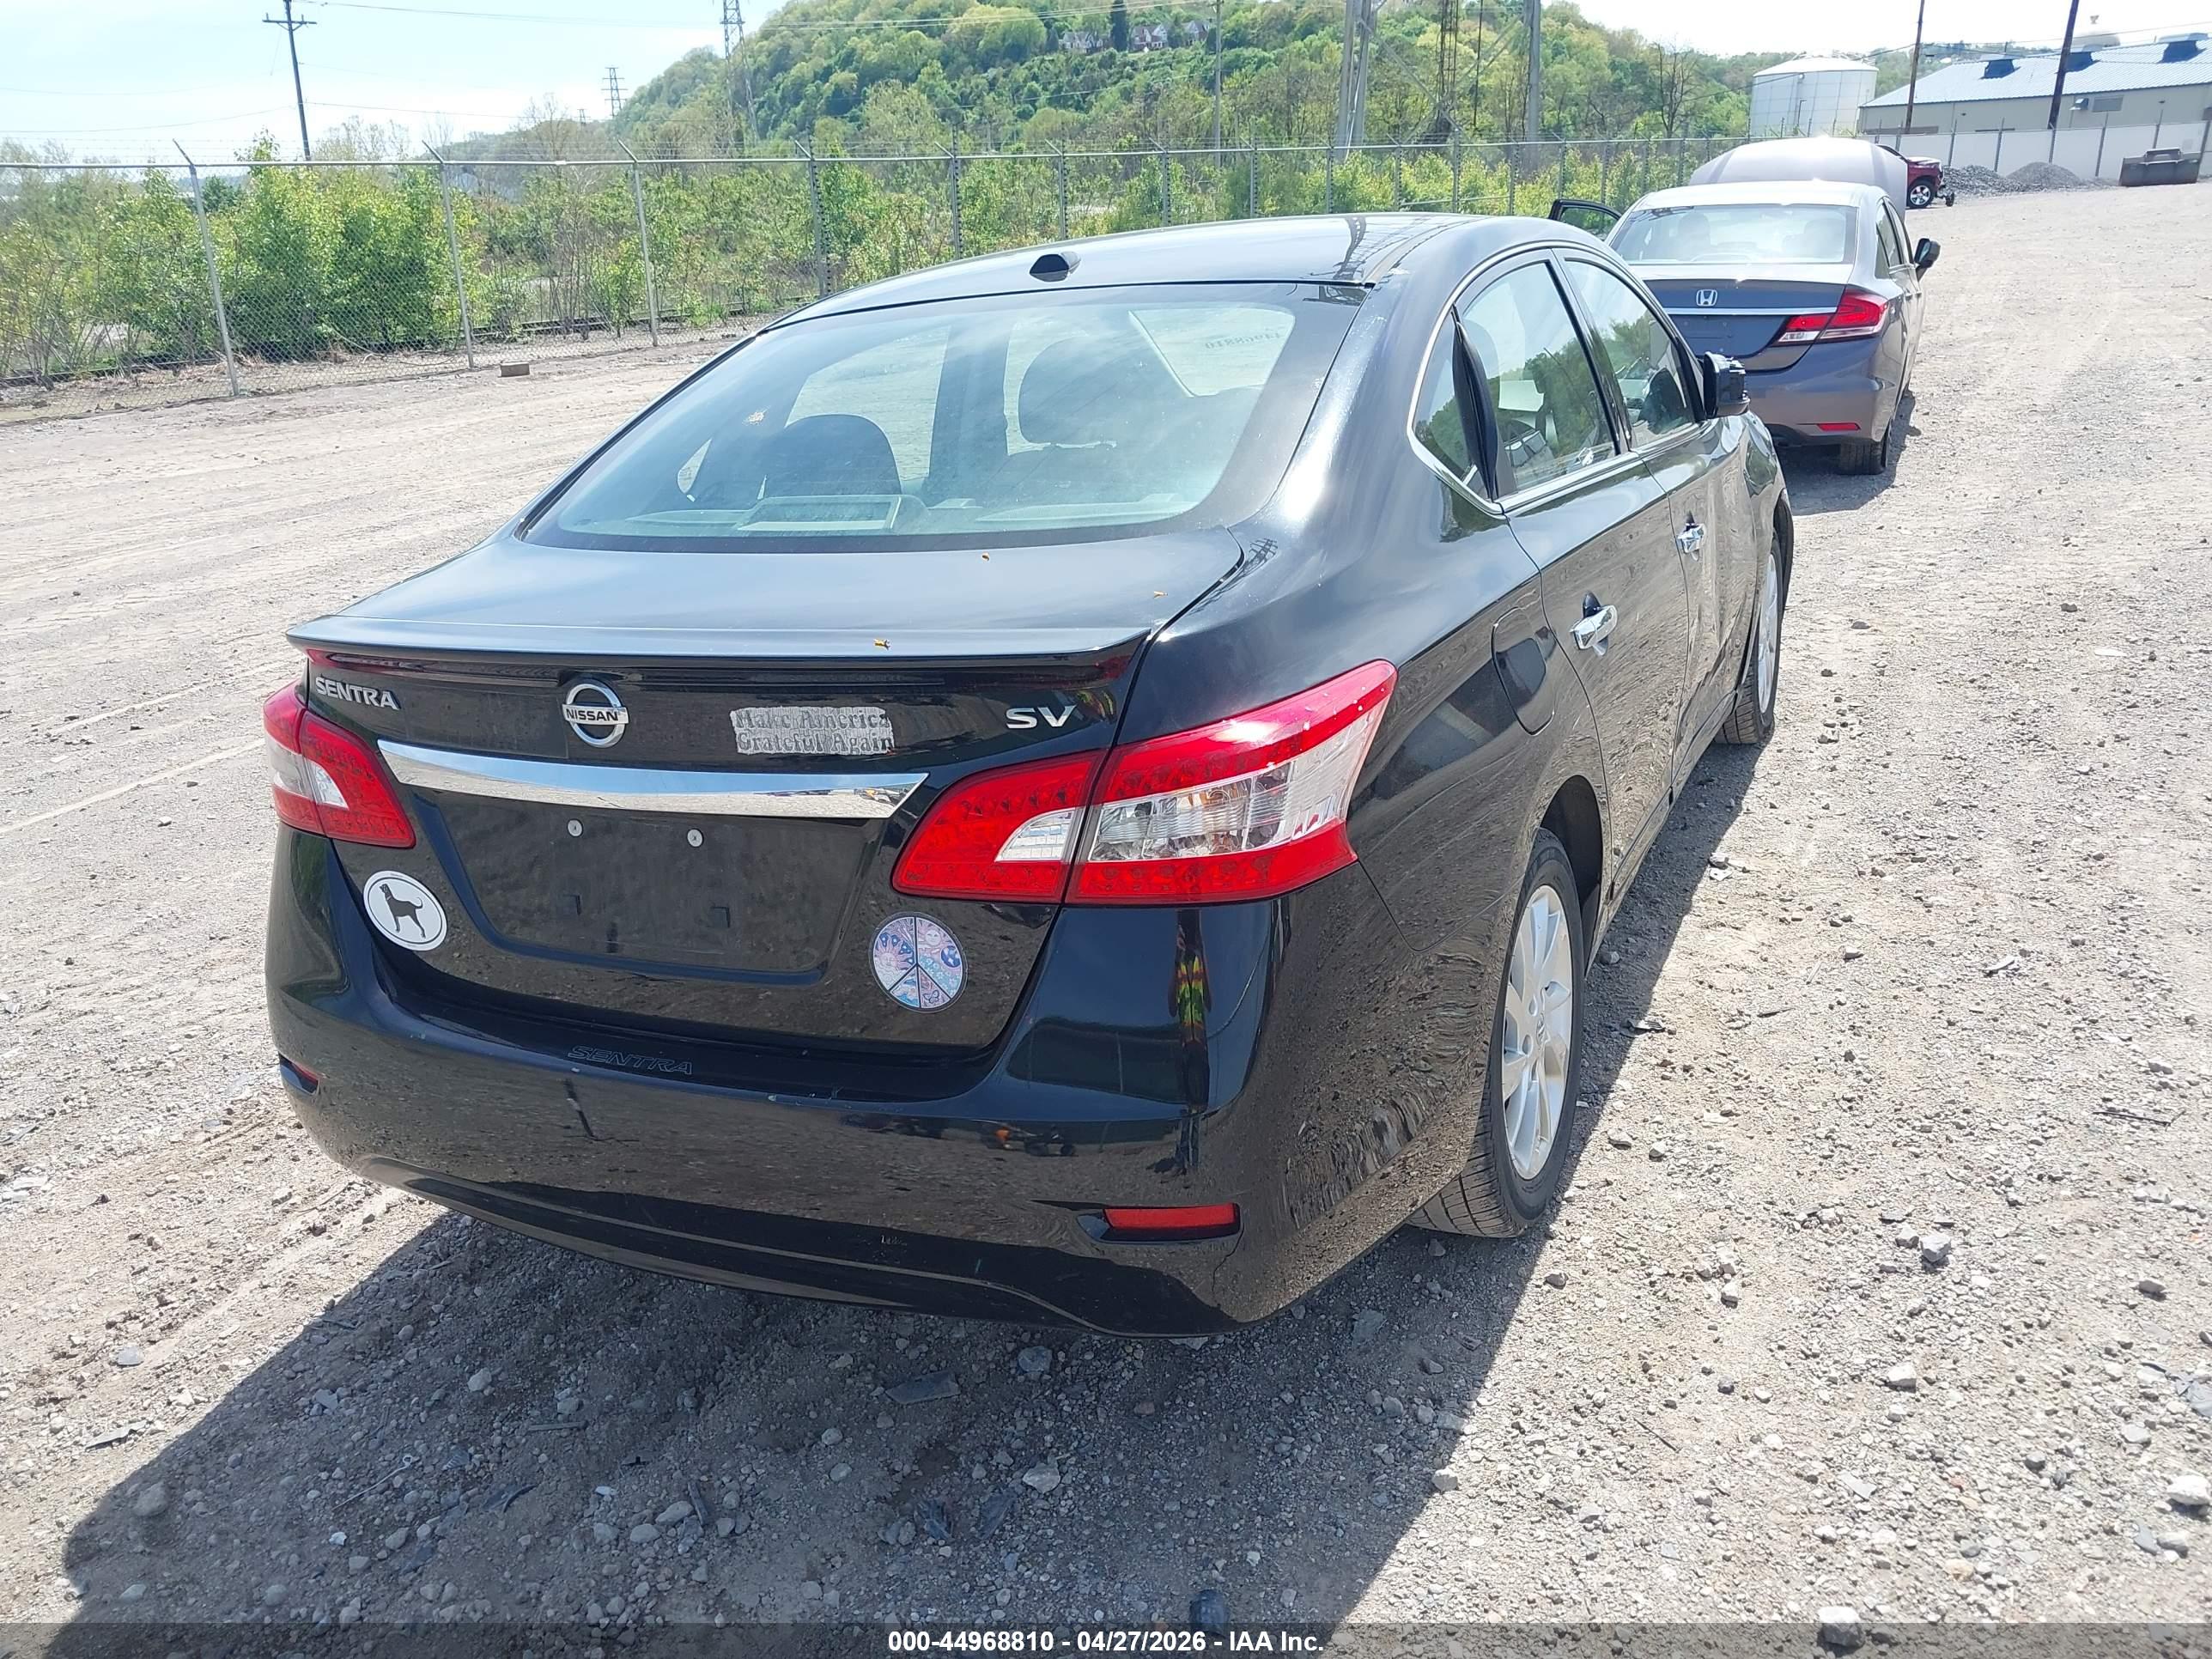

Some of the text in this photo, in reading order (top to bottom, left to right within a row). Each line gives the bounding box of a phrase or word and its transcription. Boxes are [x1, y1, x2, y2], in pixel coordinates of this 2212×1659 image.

[315, 676, 401, 711] SENTRA
[565, 707, 619, 723] NISSAN
[735, 709, 890, 729] Make America
[1006, 705, 1078, 729] SV
[737, 731, 894, 754] Grateful Again
[568, 1045, 693, 1075] SENTRA
